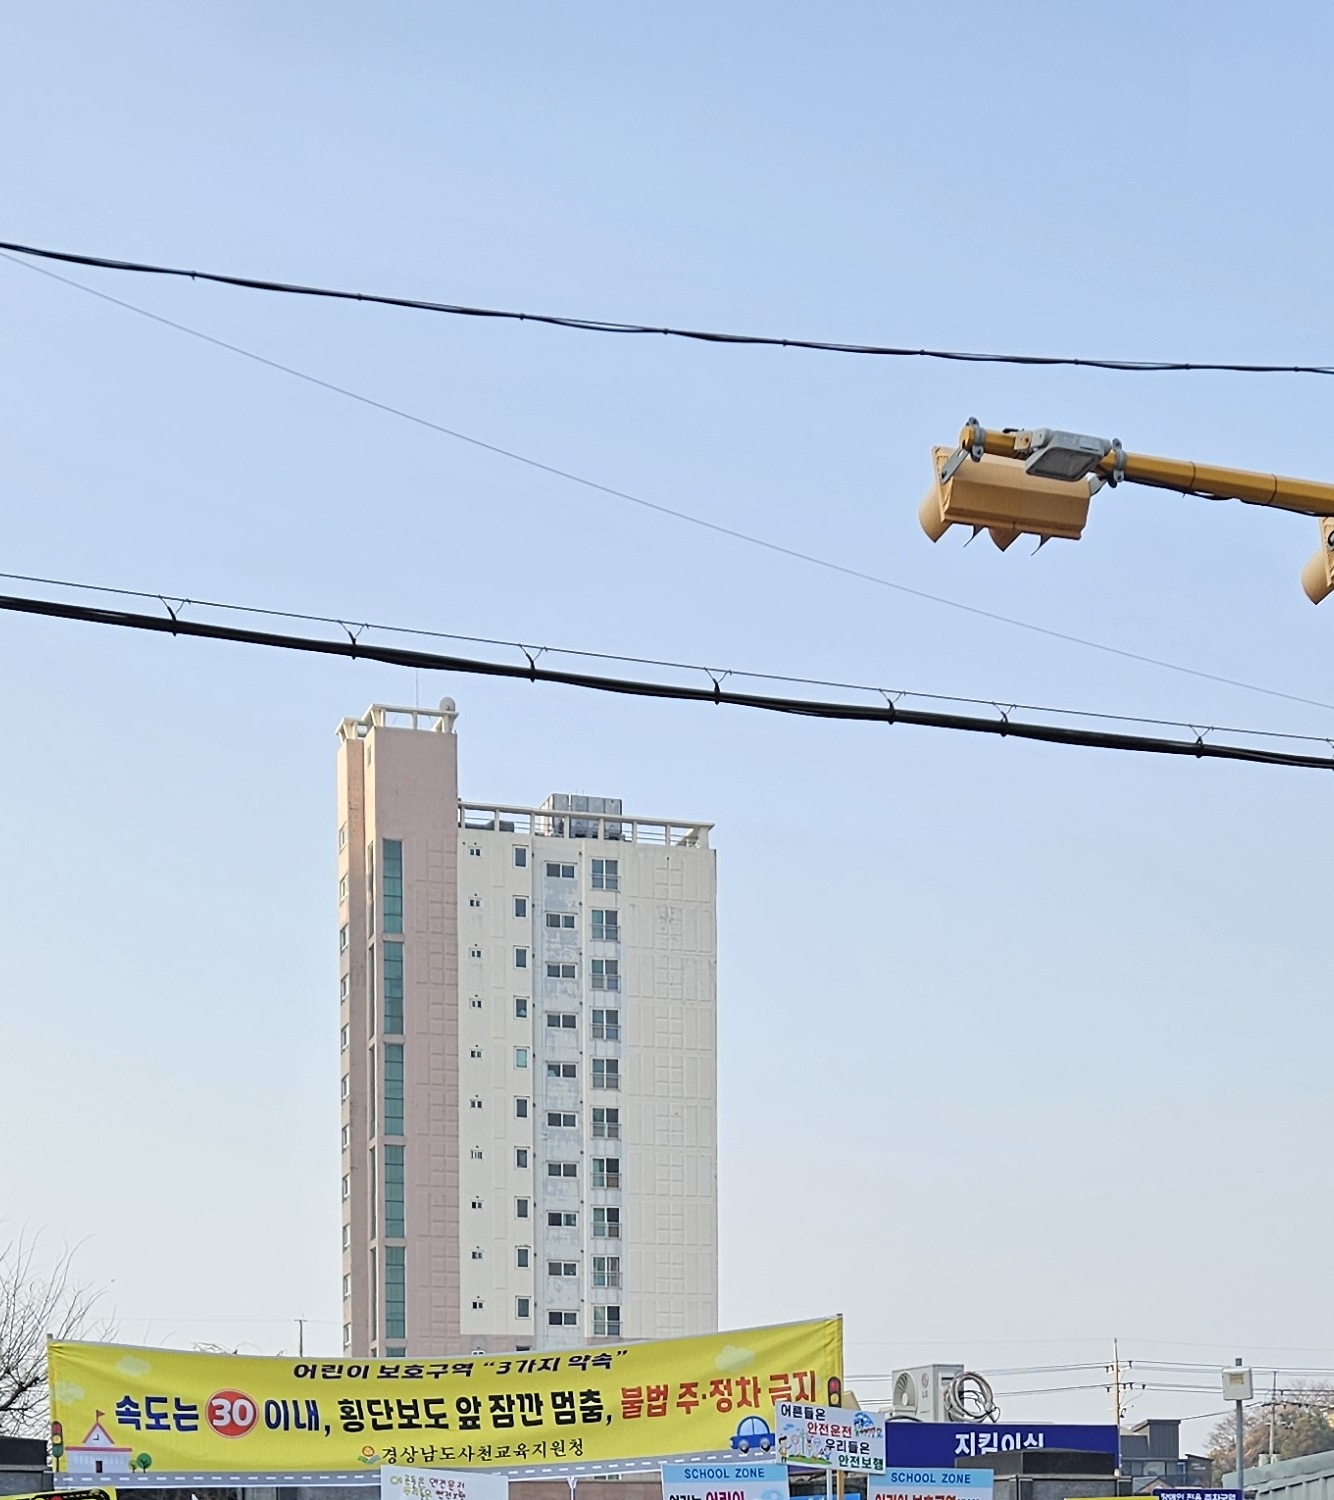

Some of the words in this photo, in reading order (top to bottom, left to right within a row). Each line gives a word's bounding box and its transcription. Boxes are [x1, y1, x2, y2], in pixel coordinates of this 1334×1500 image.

[293, 1363, 370, 1380] 어린이
[376, 1358, 474, 1380] 보호구역
[114, 1394, 201, 1433] 속도는
[209, 1398, 249, 1428] 30
[264, 1397, 331, 1438] 이내,
[338, 1397, 450, 1432] 횡단보도
[455, 1394, 483, 1432] 앞
[488, 1393, 545, 1429] 잠깐
[550, 1387, 613, 1429] 멈춤,
[619, 1383, 670, 1421] 불법
[675, 1376, 763, 1415] 주·정차
[768, 1369, 817, 1407] 금지
[780, 1403, 826, 1421] 어른들은
[807, 1421, 852, 1439] 안전운전
[381, 1437, 585, 1466] 경상남도사천교육지원청
[825, 1438, 870, 1455] 우리들은
[838, 1454, 884, 1471] 안전보행
[684, 1468, 730, 1479] SCHOOL
[735, 1467, 765, 1478] ZONE
[891, 1472, 936, 1484] SCHOOL
[941, 1473, 971, 1484] ZONE
